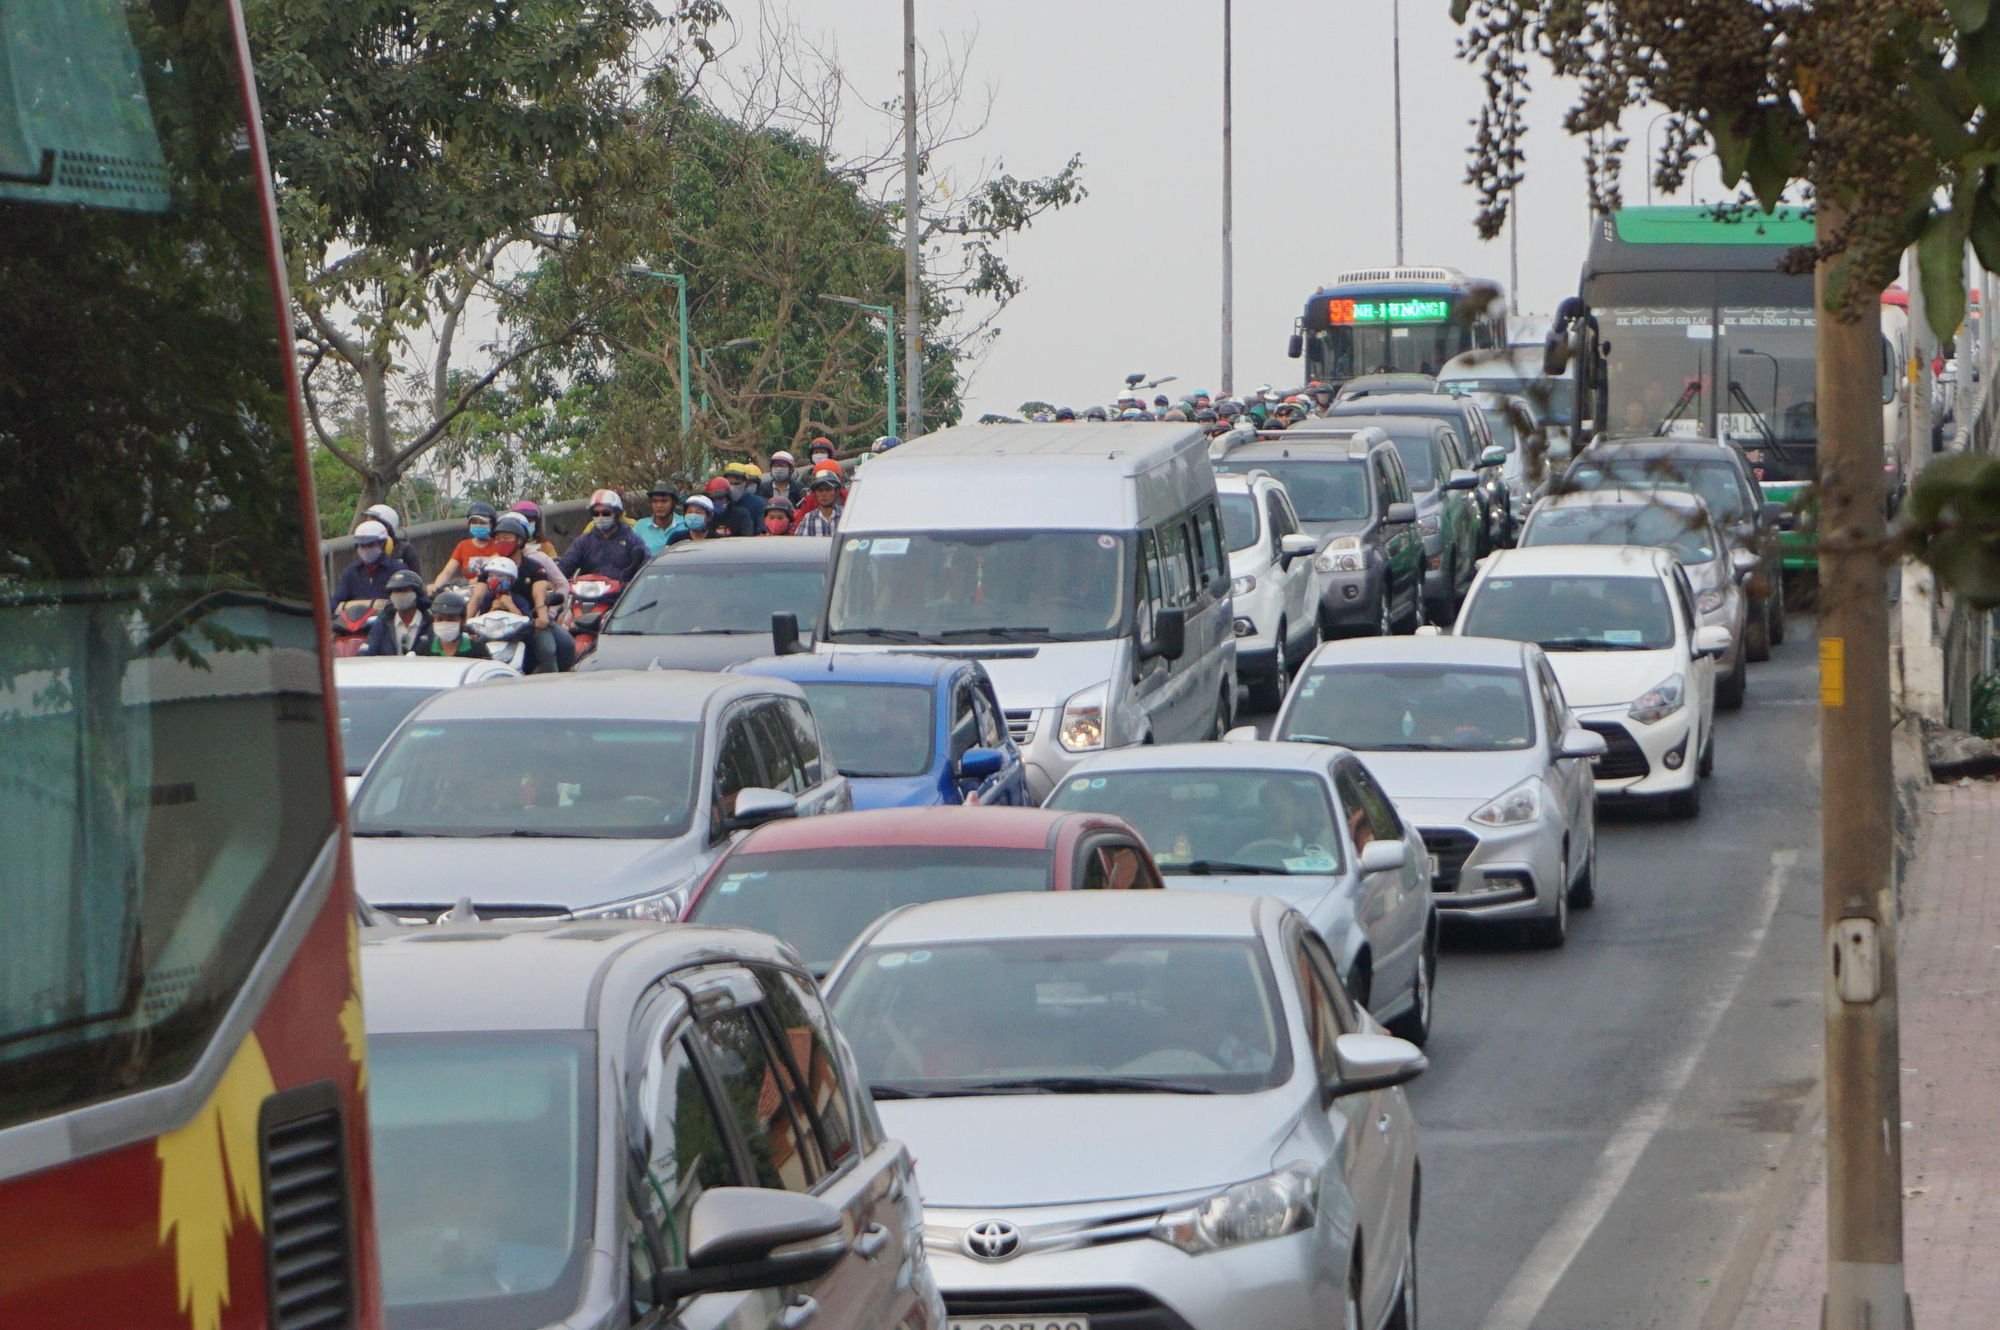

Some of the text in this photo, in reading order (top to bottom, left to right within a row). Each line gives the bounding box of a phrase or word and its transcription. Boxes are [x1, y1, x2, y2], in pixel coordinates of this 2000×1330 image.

[1651, 316, 1674, 325] LONG
[1675, 316, 1691, 325] GIA
[1691, 316, 1708, 325] LAI
